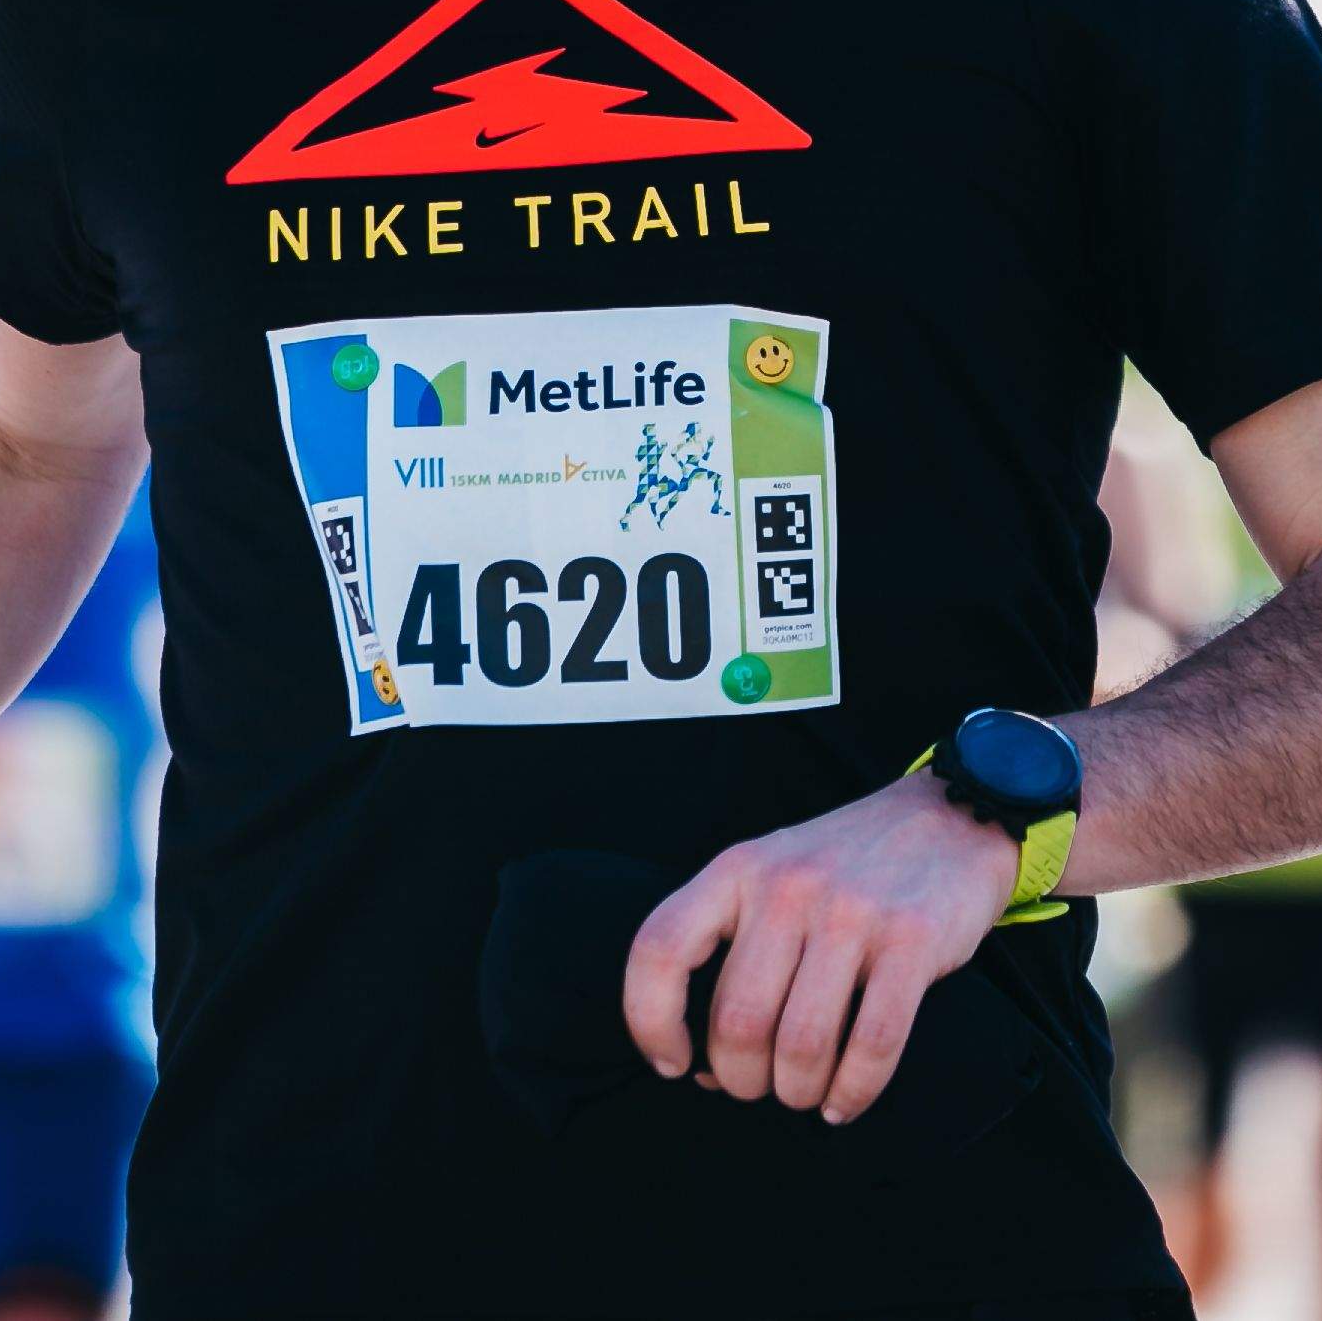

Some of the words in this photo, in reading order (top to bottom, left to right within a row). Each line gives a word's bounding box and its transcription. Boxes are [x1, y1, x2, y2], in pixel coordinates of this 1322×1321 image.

[267, 200, 464, 263] NIKE
[513, 180, 771, 249] TRAIL
[489, 359, 706, 415] MetLife
[393, 456, 445, 488] VIII
[450, 474, 492, 488] 15KM
[497, 471, 562, 486] MADRID
[396, 552, 713, 688] 4620
